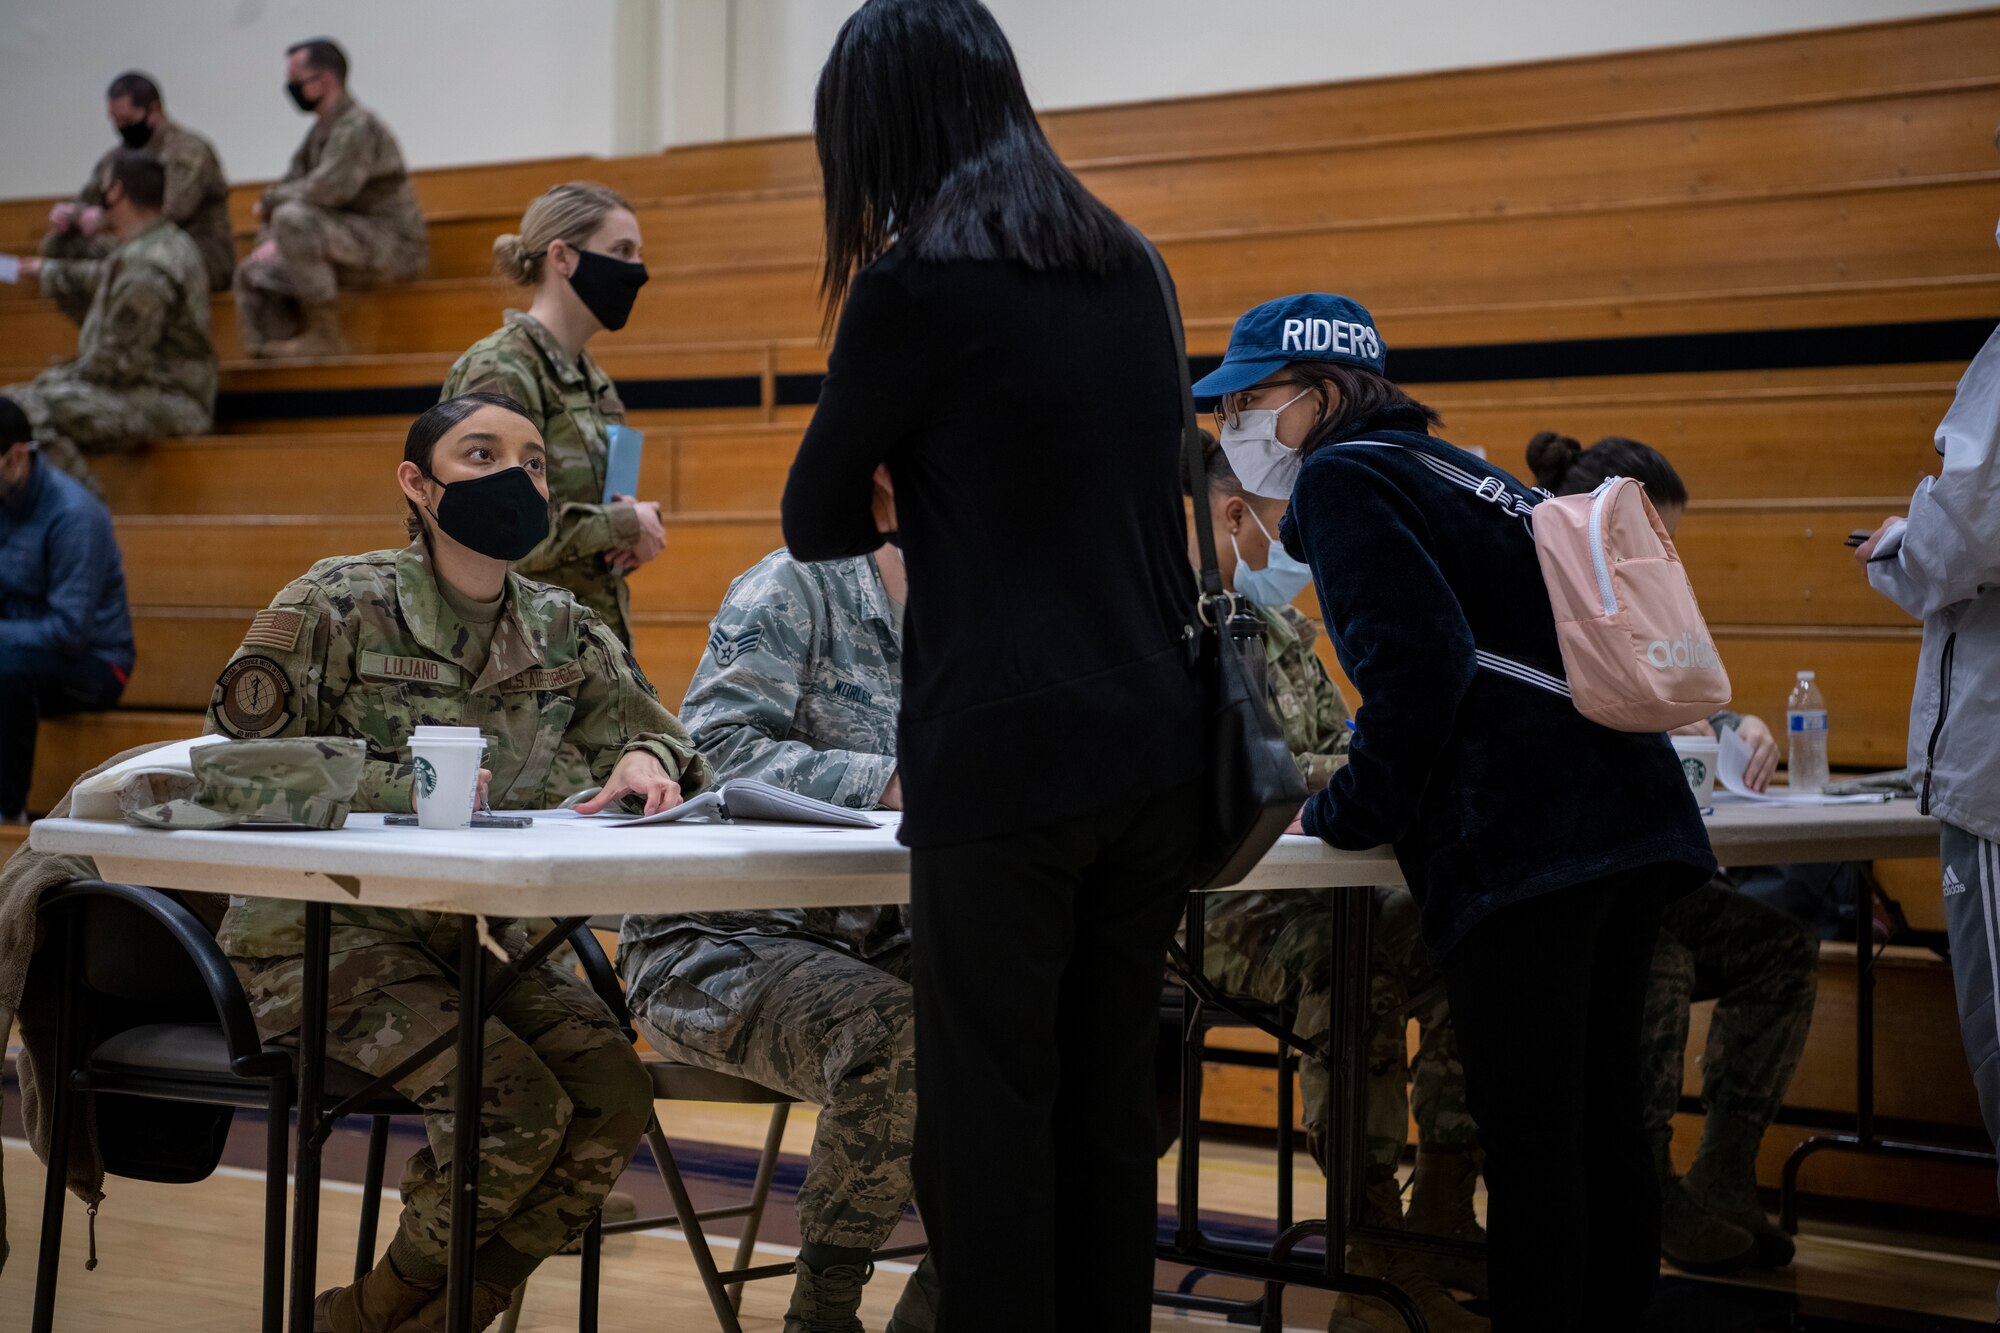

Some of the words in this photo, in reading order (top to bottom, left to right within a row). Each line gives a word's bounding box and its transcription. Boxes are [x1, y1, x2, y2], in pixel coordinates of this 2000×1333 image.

[1282, 318, 1380, 359] RIDERS
[384, 656, 438, 680] LUJANO
[1647, 631, 1719, 674] adid
[223, 665, 239, 684] GLOBAL
[239, 659, 259, 668] SERVICE
[259, 659, 272, 670] WITH
[270, 665, 290, 692] INTEGRITY
[833, 679, 872, 707] WORLEY
